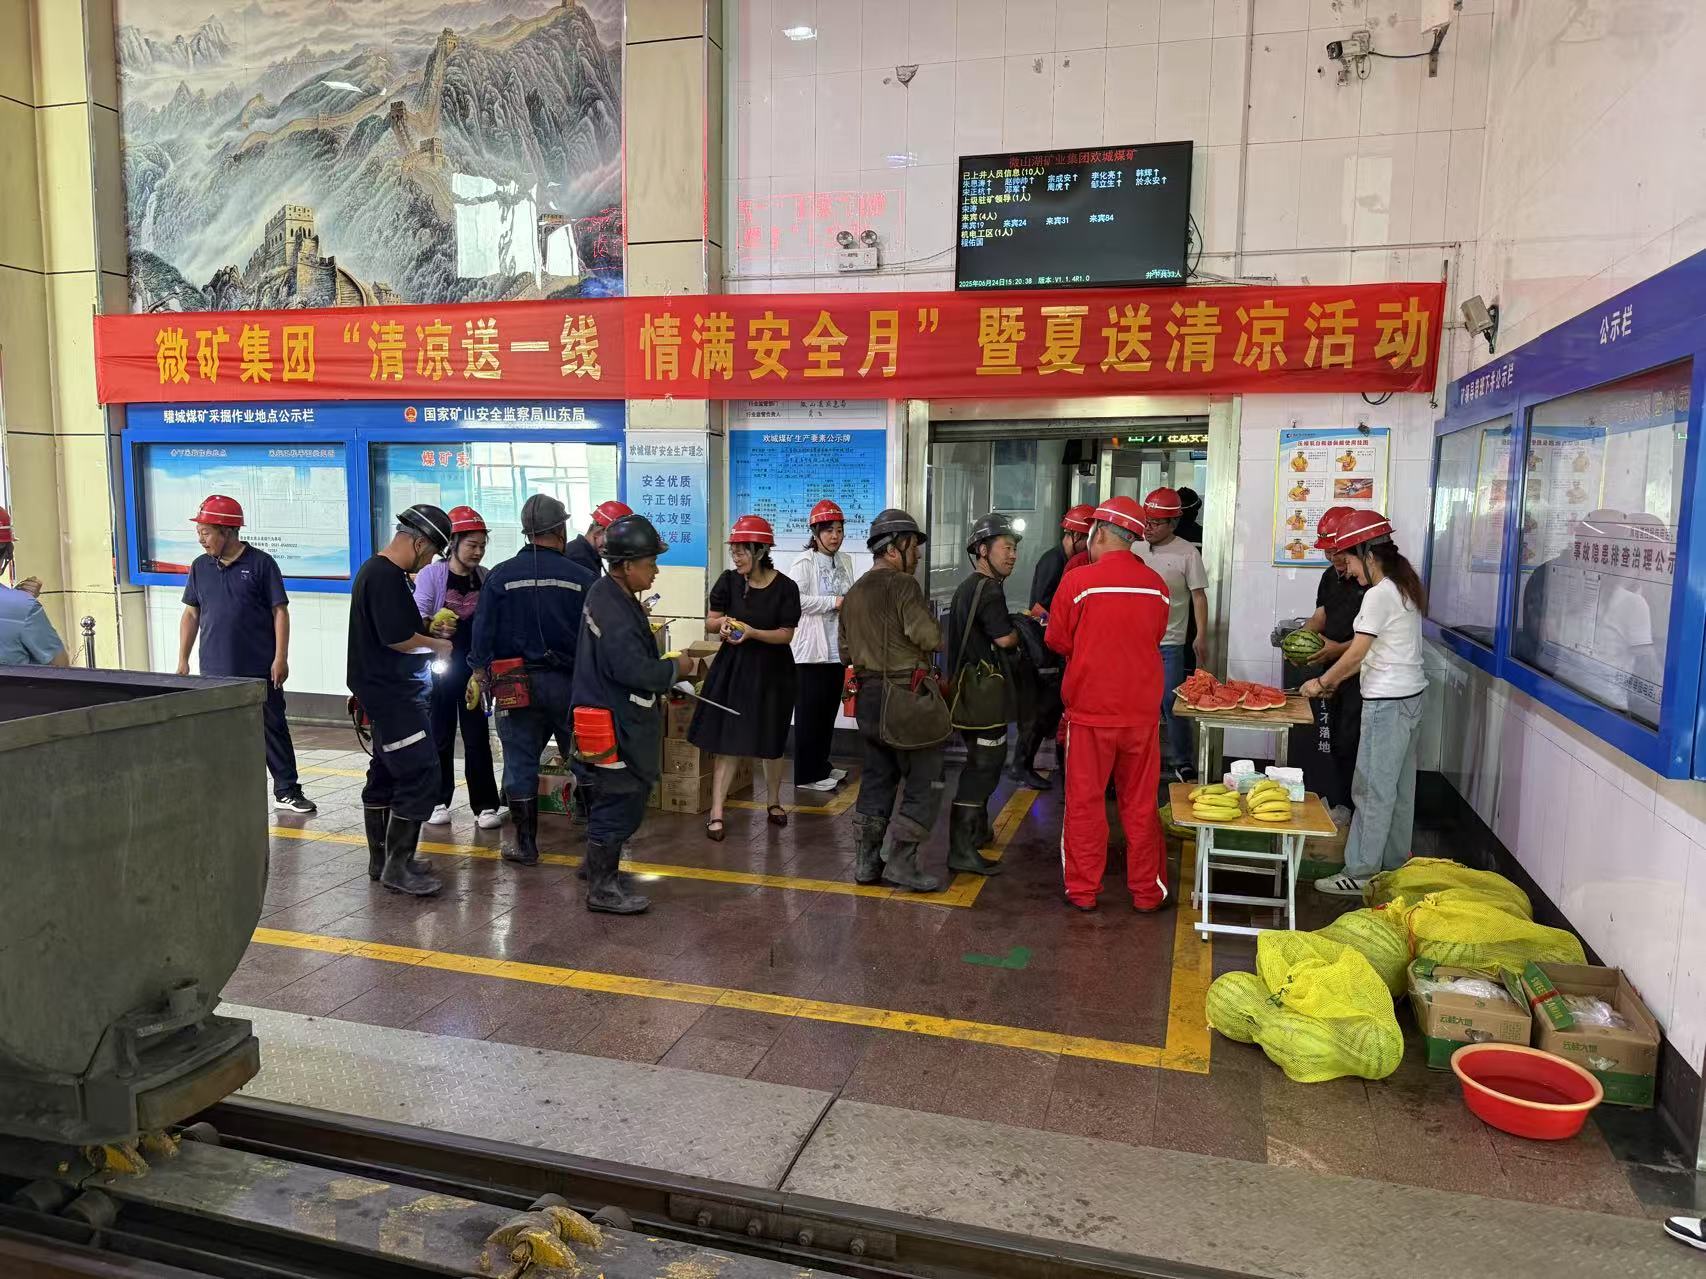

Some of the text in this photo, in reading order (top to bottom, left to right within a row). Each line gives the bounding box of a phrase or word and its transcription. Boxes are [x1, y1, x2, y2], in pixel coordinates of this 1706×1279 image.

[1009, 149, 1137, 168] 微山湖矿业集团欢城煤矿
[1003, 219, 1027, 228] 来宾24
[1046, 217, 1069, 226] 来宾31
[1600, 304, 1633, 345] 公示栏
[155, 324, 316, 384] 微矿集团
[976, 296, 1430, 376] 暨夏送清凉活动
[424, 407, 586, 422] 国家矿山安全监察局山东局
[762, 434, 851, 444] 欢城煤矿生产要素公示牌
[629, 445, 704, 457] 欢城煤矿安全生产理念
[642, 475, 691, 488] 安全优质
[642, 494, 692, 507] 守正创新
